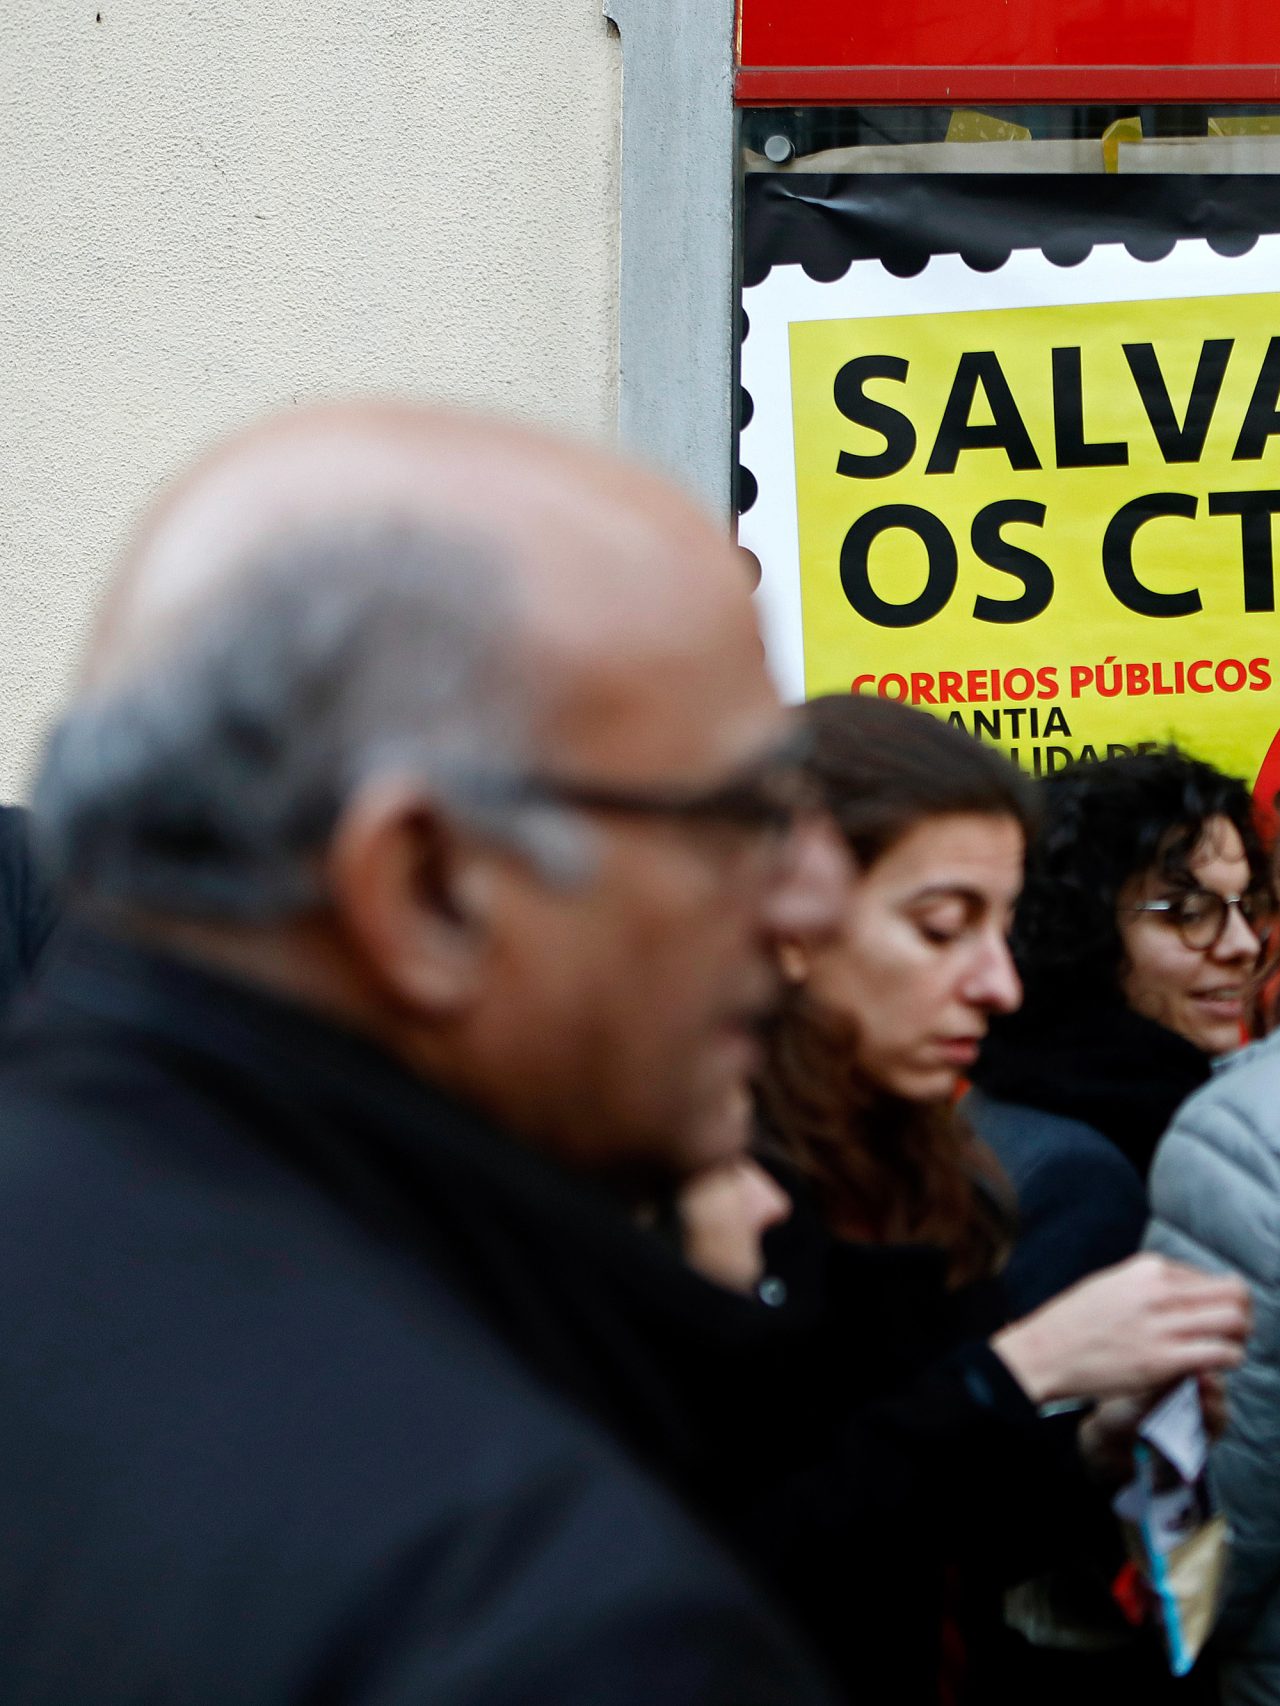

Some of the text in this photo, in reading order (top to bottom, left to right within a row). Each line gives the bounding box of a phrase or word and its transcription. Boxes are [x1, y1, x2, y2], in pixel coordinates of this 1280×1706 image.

[838, 498, 1055, 629] OS
[850, 656, 1273, 706] CORREIOS PÚBLICOS
[923, 706, 1073, 740] ANTIA
